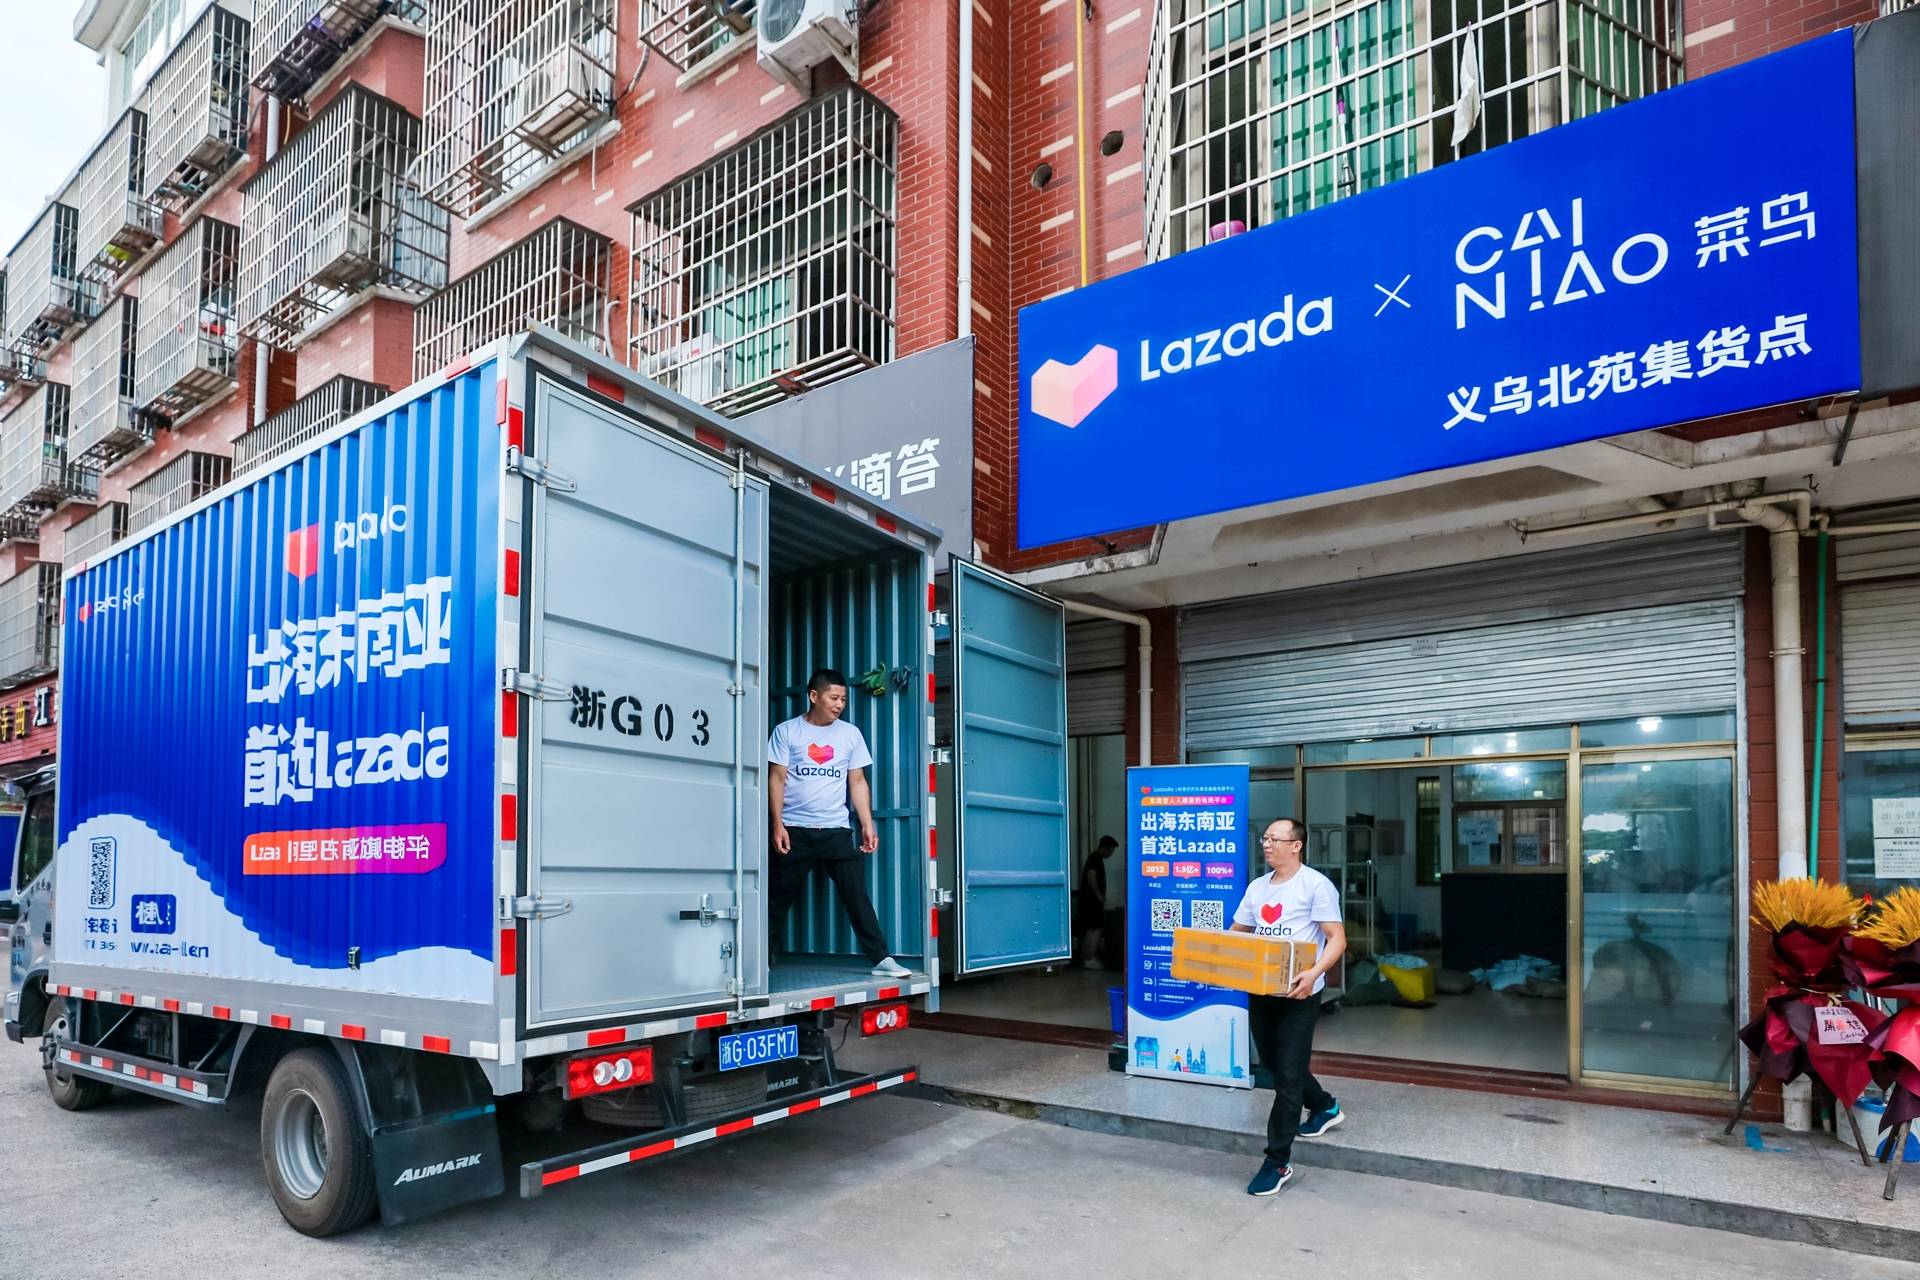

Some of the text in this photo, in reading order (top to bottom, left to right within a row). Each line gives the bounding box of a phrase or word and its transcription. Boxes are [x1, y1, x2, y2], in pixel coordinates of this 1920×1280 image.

[1695, 191, 1817, 268] 菜鸟
[1140, 292, 1334, 382] Lazada
[1443, 313, 1813, 430] 义乌北苑集货点
[824, 437, 941, 501] 滴答
[796, 764, 841, 779] Lazada
[1140, 811, 1236, 831] 出海东南亚
[1140, 835, 1236, 855] 首选Lazada
[1145, 866, 1165, 874] 2012
[1206, 866, 1233, 875] 100%+
[1257, 924, 1292, 936] zada
[393, 1152, 482, 1186] AUMARK
